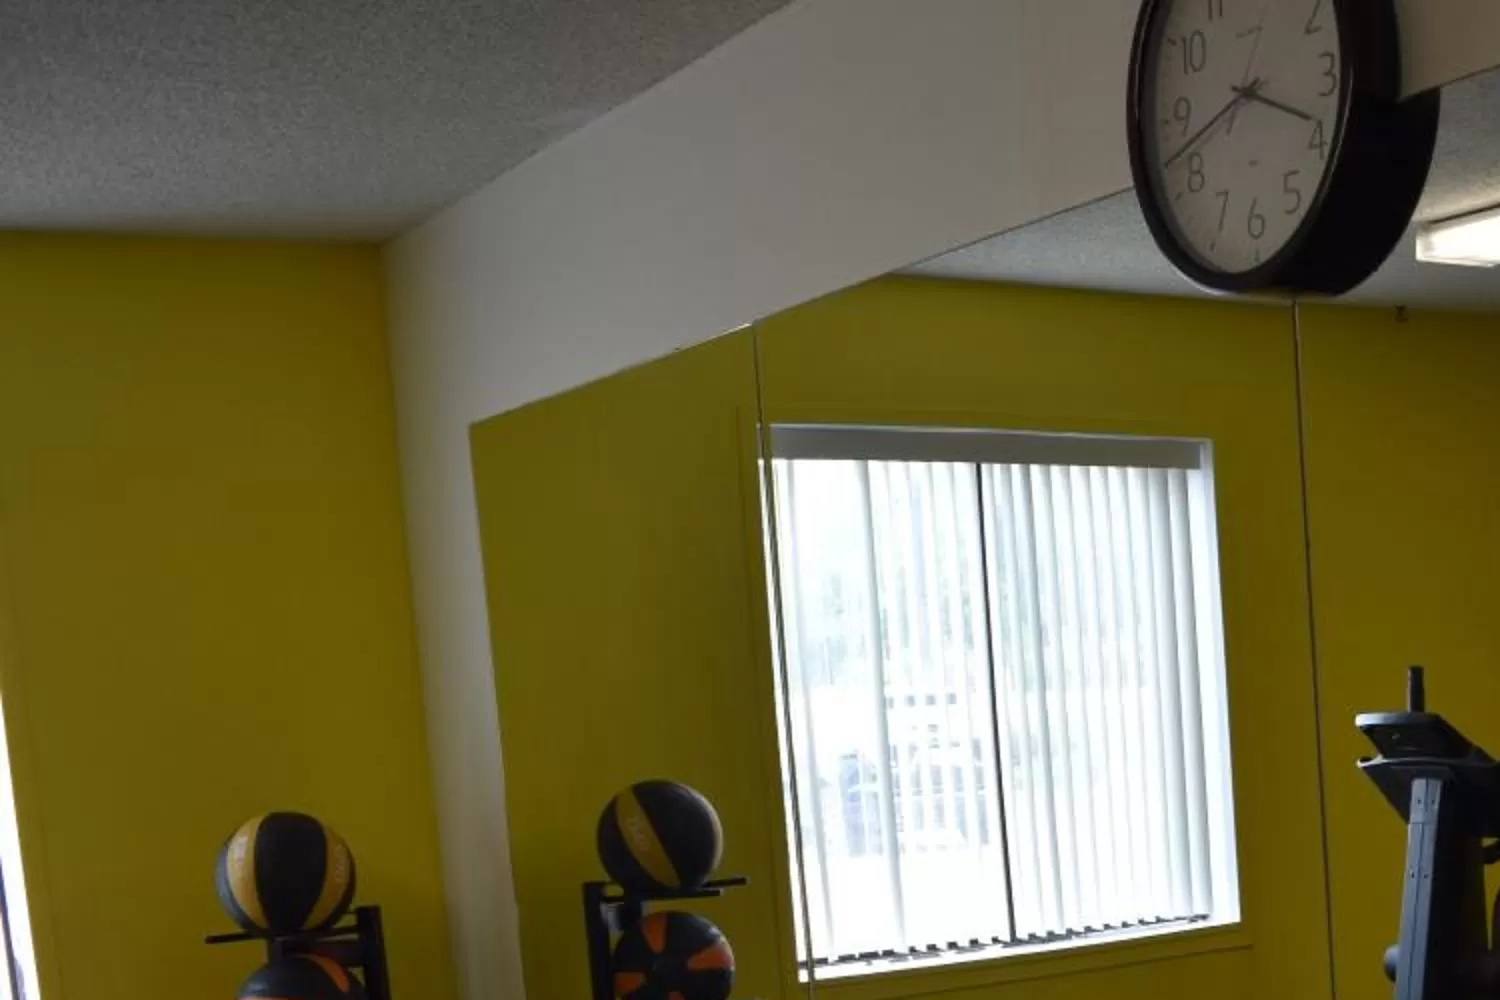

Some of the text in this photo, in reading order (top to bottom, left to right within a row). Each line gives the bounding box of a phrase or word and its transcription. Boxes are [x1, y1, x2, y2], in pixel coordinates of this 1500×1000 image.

[1181, 29, 1207, 75] 10
[1318, 52, 1337, 97] 3
[1173, 97, 1192, 137] 9
[1307, 118, 1328, 161] 4
[1187, 151, 1205, 193] 8
[1282, 170, 1301, 215] 5
[1215, 191, 1229, 234] 7
[1247, 197, 1266, 239] 6
